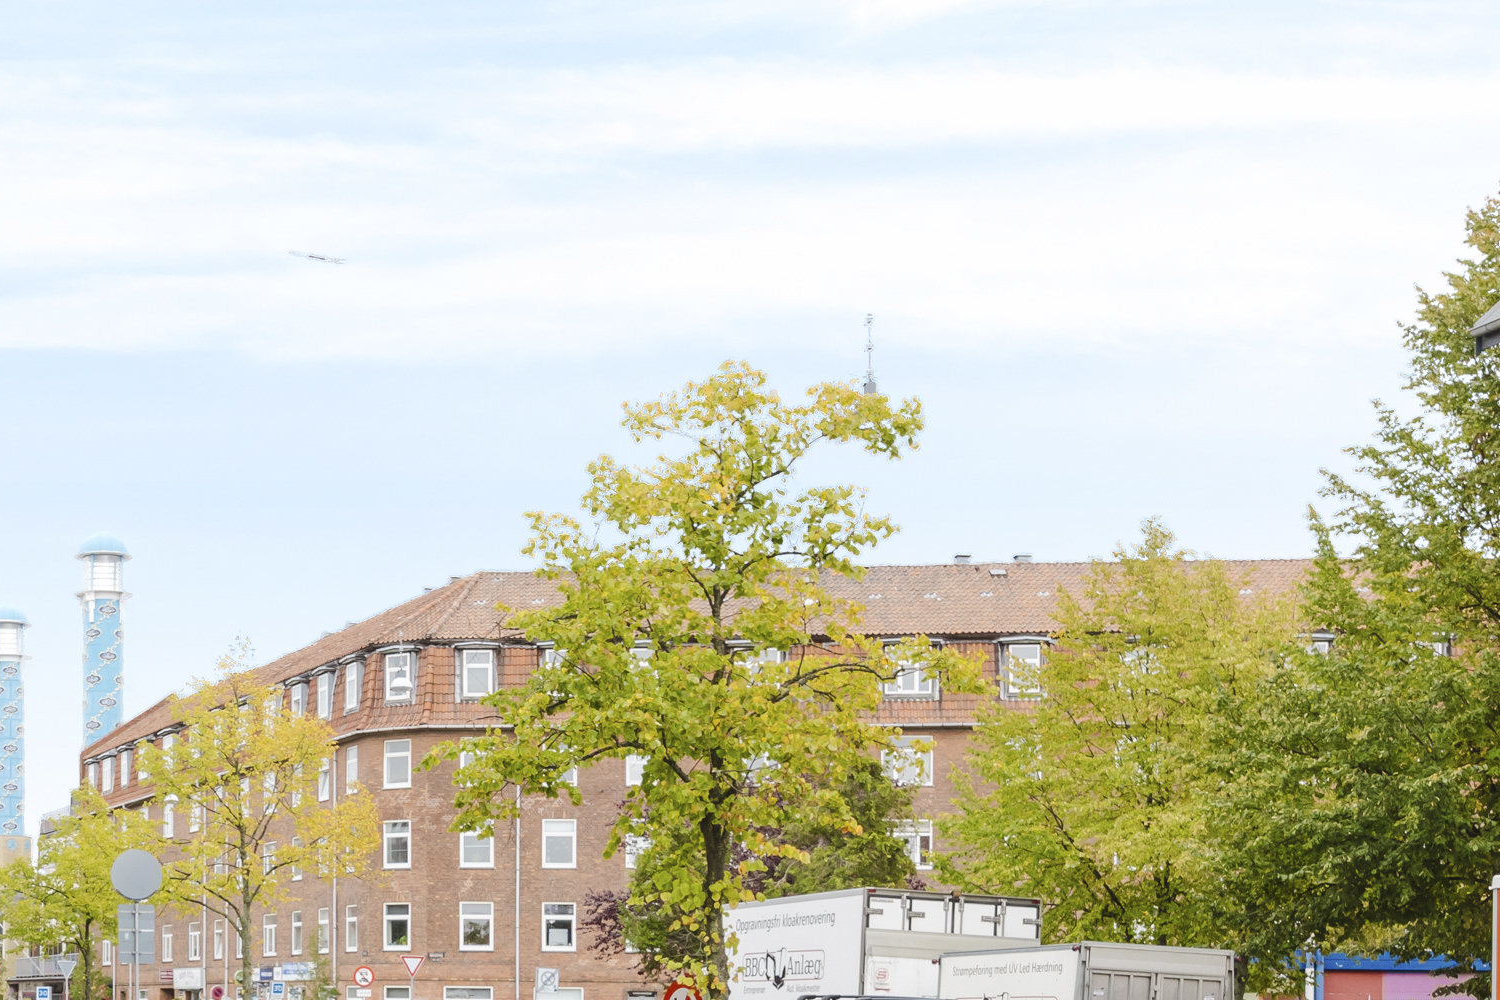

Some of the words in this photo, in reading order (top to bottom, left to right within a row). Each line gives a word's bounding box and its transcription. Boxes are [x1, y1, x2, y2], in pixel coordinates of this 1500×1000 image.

[736, 914, 781, 934] Opgravningsfri
[782, 912, 836, 927] kloakrenovering
[745, 957, 766, 977] BBC
[786, 954, 821, 980] Anlæg
[952, 964, 993, 978] Strømpeforing
[994, 964, 1007, 975] med
[1008, 962, 1019, 974] UV
[1019, 961, 1030, 973] Led
[1031, 961, 1063, 974] Hærdning
